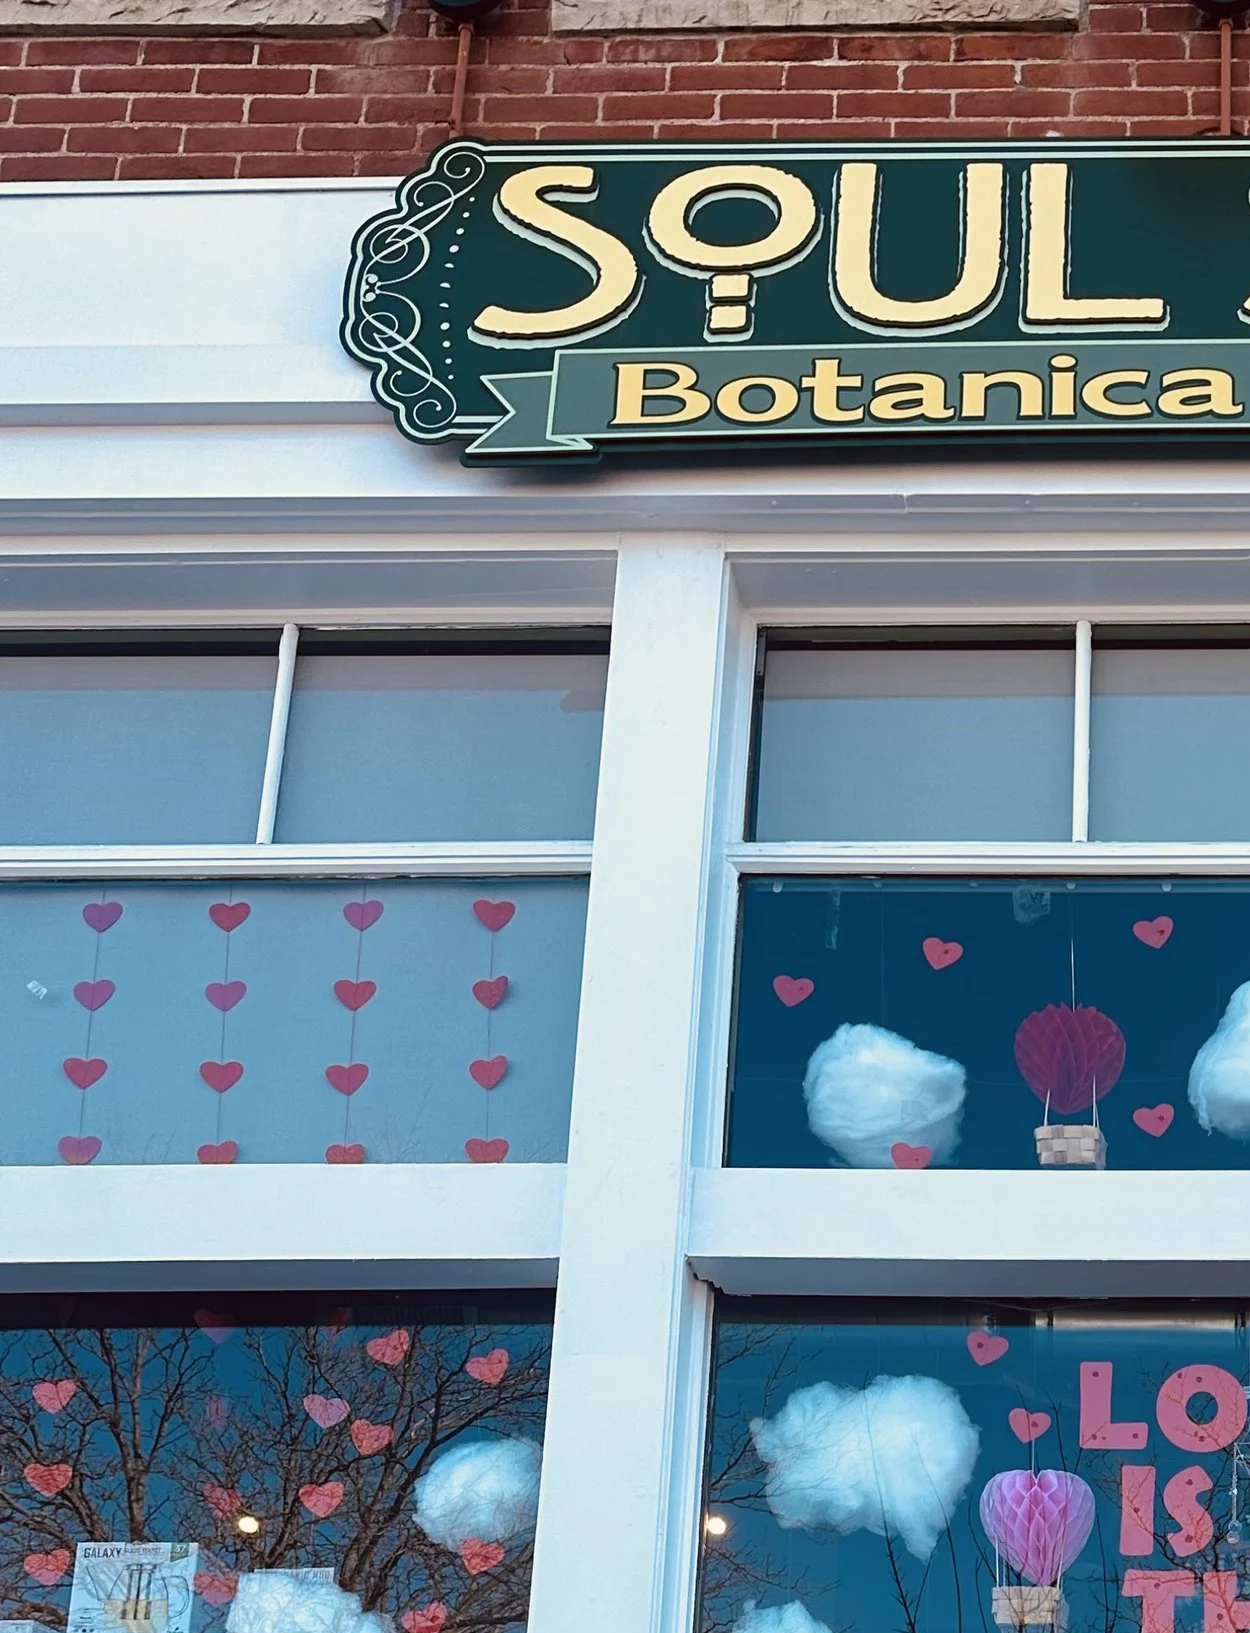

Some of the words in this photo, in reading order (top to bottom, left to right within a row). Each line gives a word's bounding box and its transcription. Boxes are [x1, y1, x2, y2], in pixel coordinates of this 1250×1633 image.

[472, 160, 1168, 340] SOUL
[609, 352, 1244, 427] Botanica
[84, 1547, 121, 1558] GALAXY
[1119, 1465, 1214, 1557] IS
